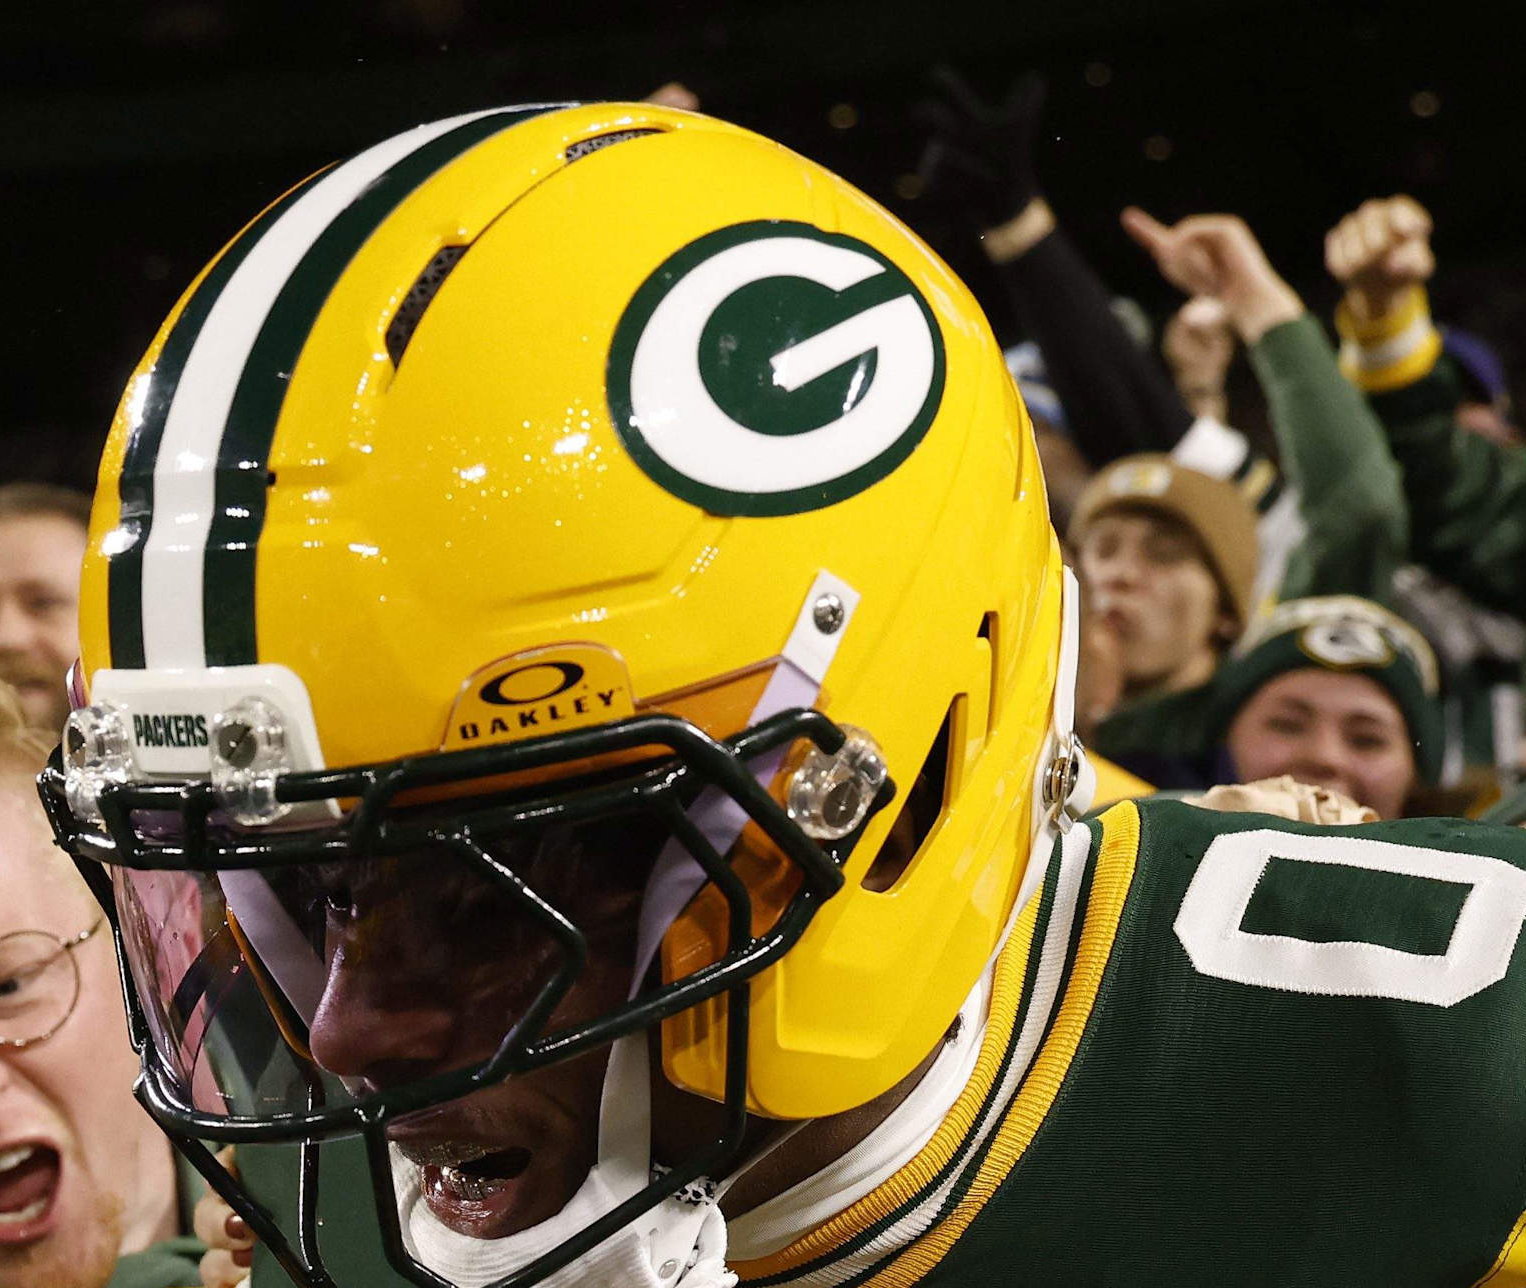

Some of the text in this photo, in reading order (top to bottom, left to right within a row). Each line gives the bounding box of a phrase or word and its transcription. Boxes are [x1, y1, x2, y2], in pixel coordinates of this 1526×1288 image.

[630, 236, 934, 494] G
[133, 714, 209, 747] PACKERS
[459, 688, 616, 740] OAKLEY
